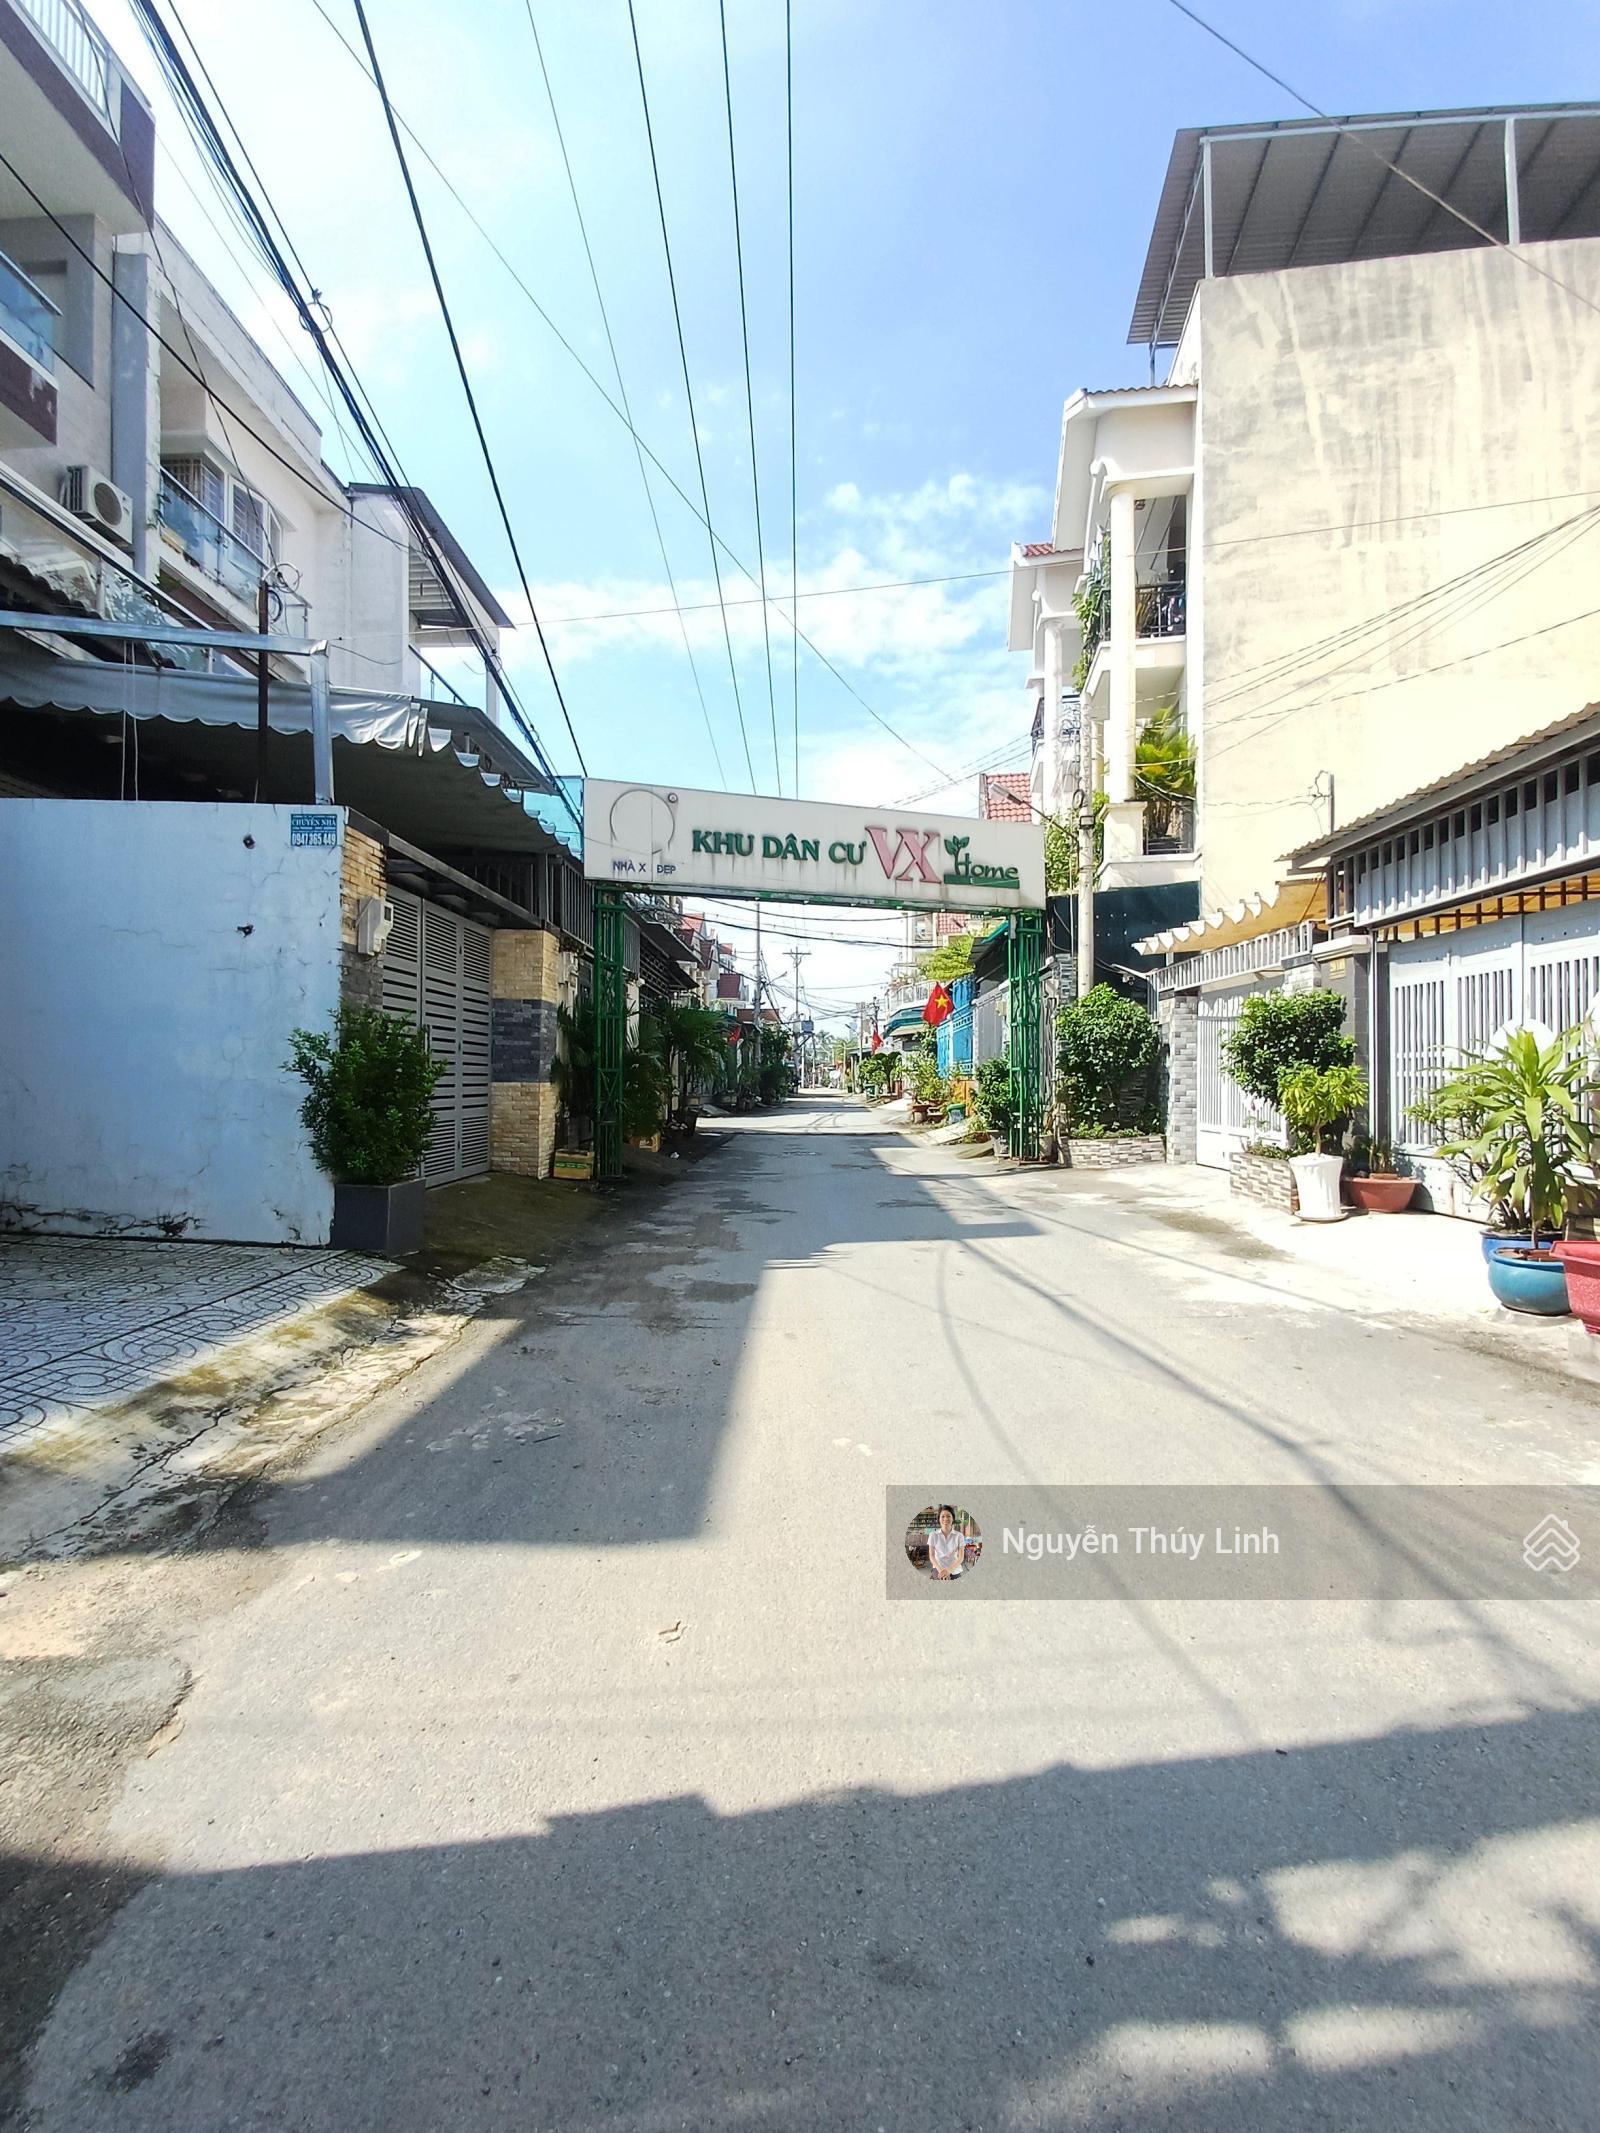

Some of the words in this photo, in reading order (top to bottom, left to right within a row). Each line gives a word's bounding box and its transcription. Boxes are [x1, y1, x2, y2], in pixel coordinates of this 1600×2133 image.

[613, 860, 636, 872] NHÀ
[692, 830, 754, 856] KHU
[762, 833, 820, 861] DÂN
[828, 841, 866, 865] CƯ
[865, 826, 942, 884] VX
[954, 852, 1019, 880] Home
